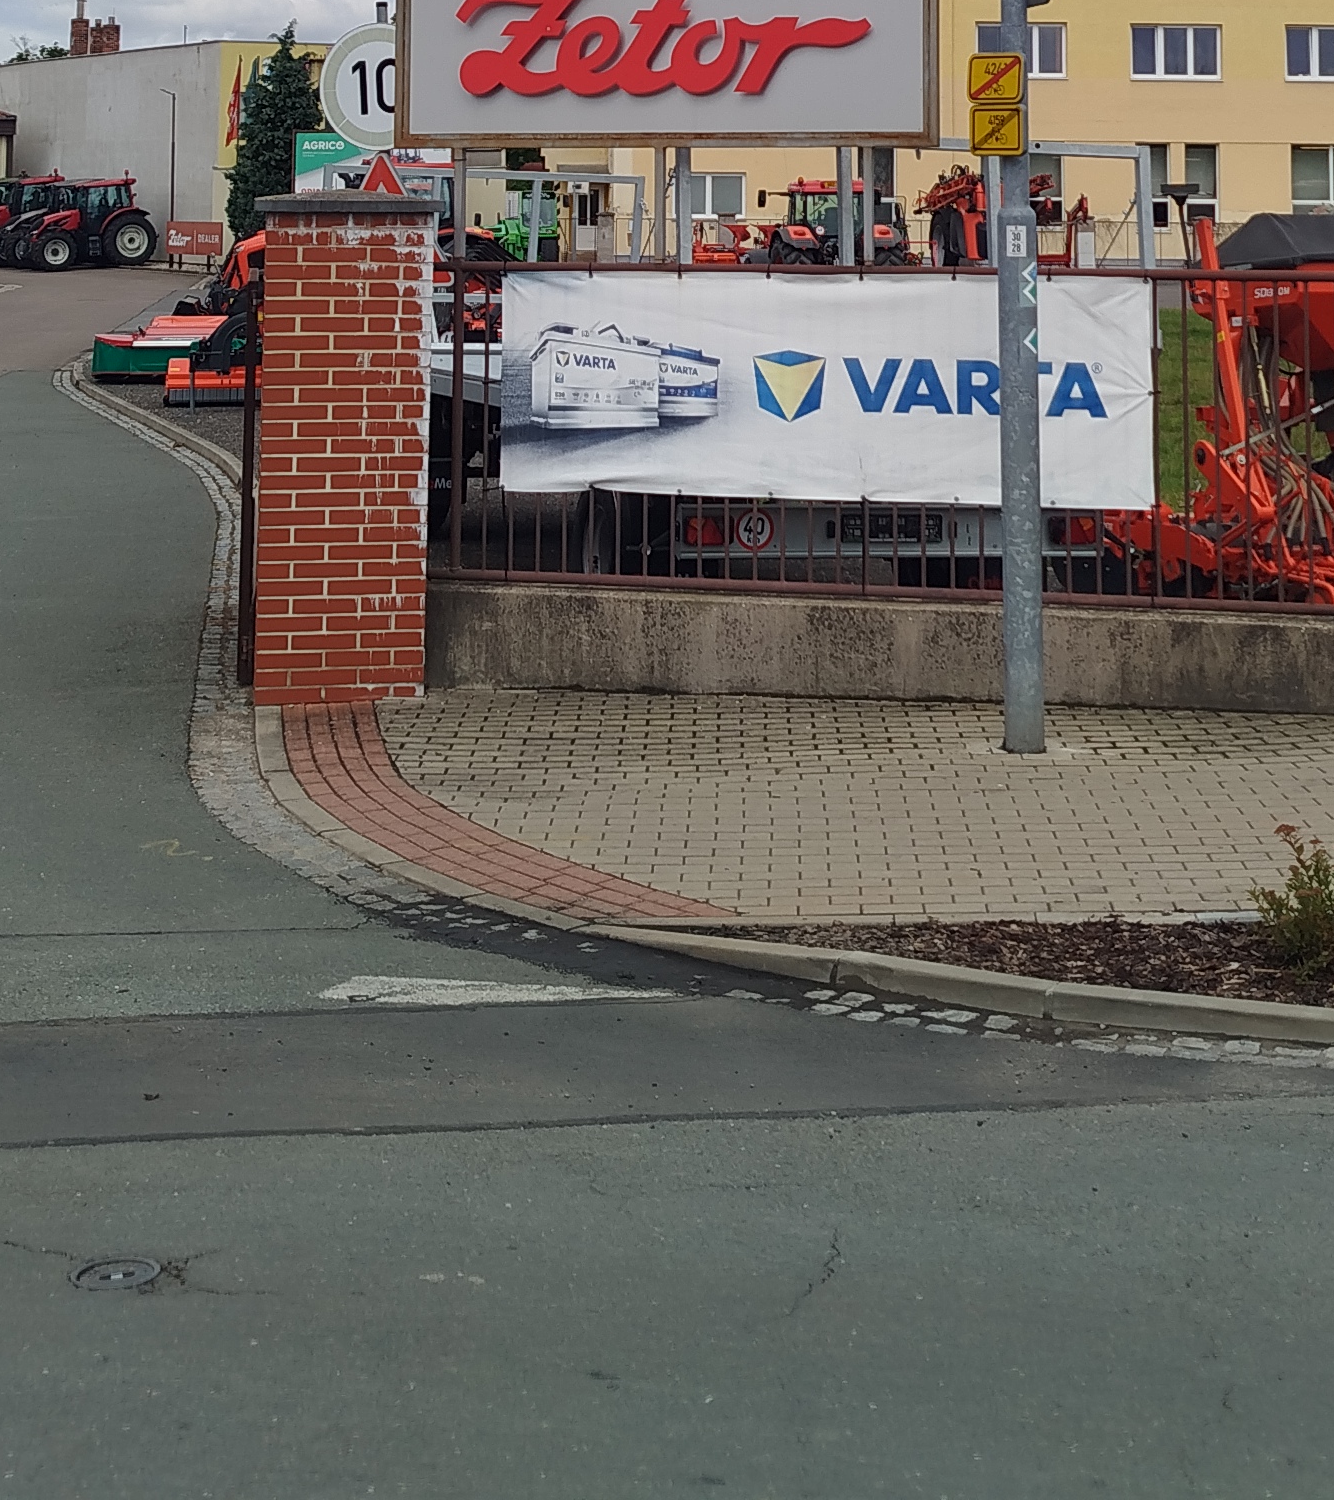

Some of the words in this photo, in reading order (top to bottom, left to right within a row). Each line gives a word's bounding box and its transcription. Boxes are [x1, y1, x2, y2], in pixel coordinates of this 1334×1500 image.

[352, 58, 395, 115] 10
[302, 140, 345, 150] AGRICO
[168, 229, 193, 247] Zetor
[197, 233, 220, 245] DEALER
[573, 353, 616, 371] VARTA
[670, 363, 699, 377] VARTA
[841, 356, 1109, 419] VARA
[743, 515, 765, 535] 40
